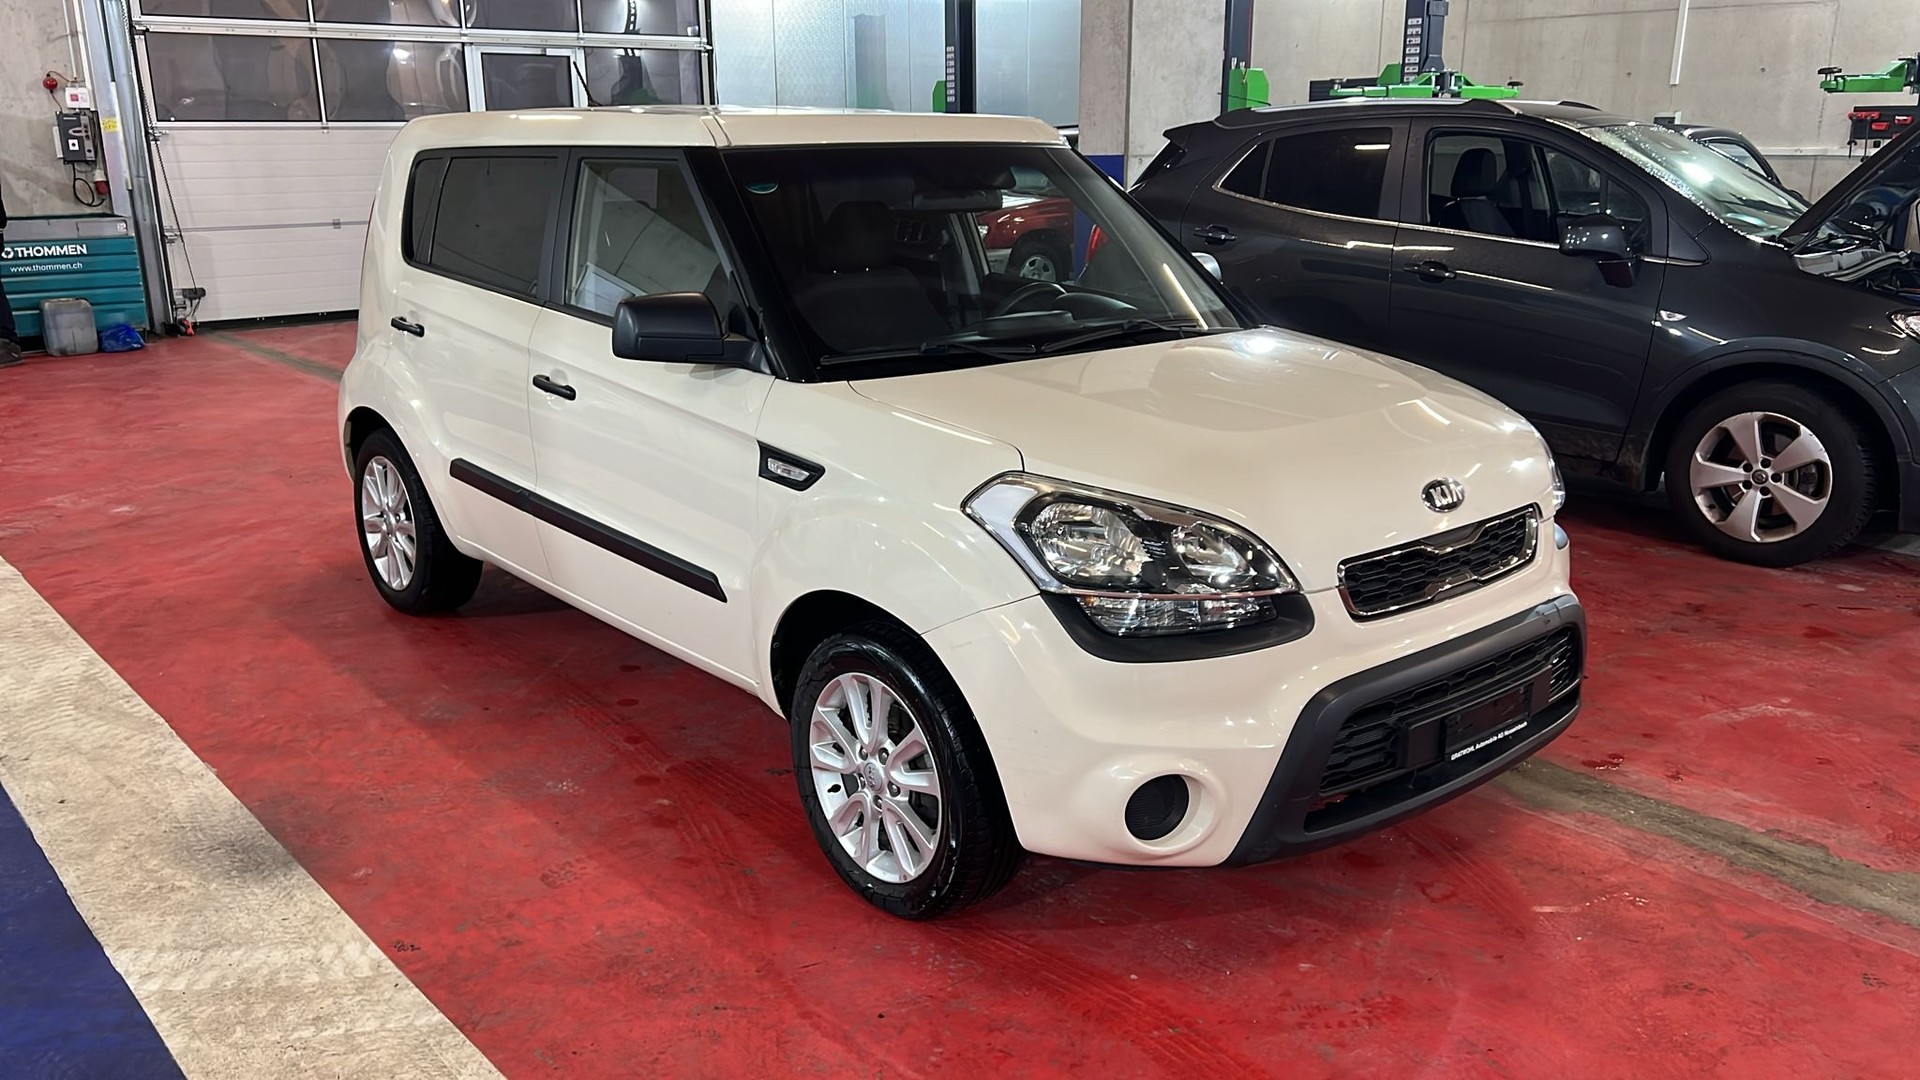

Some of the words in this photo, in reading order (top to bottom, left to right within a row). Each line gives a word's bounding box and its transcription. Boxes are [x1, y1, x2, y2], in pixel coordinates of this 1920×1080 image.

[14, 243, 88, 258] THOMMEN
[10, 262, 83, 273] www.thommen.ch
[1429, 483, 1463, 507] KIA
